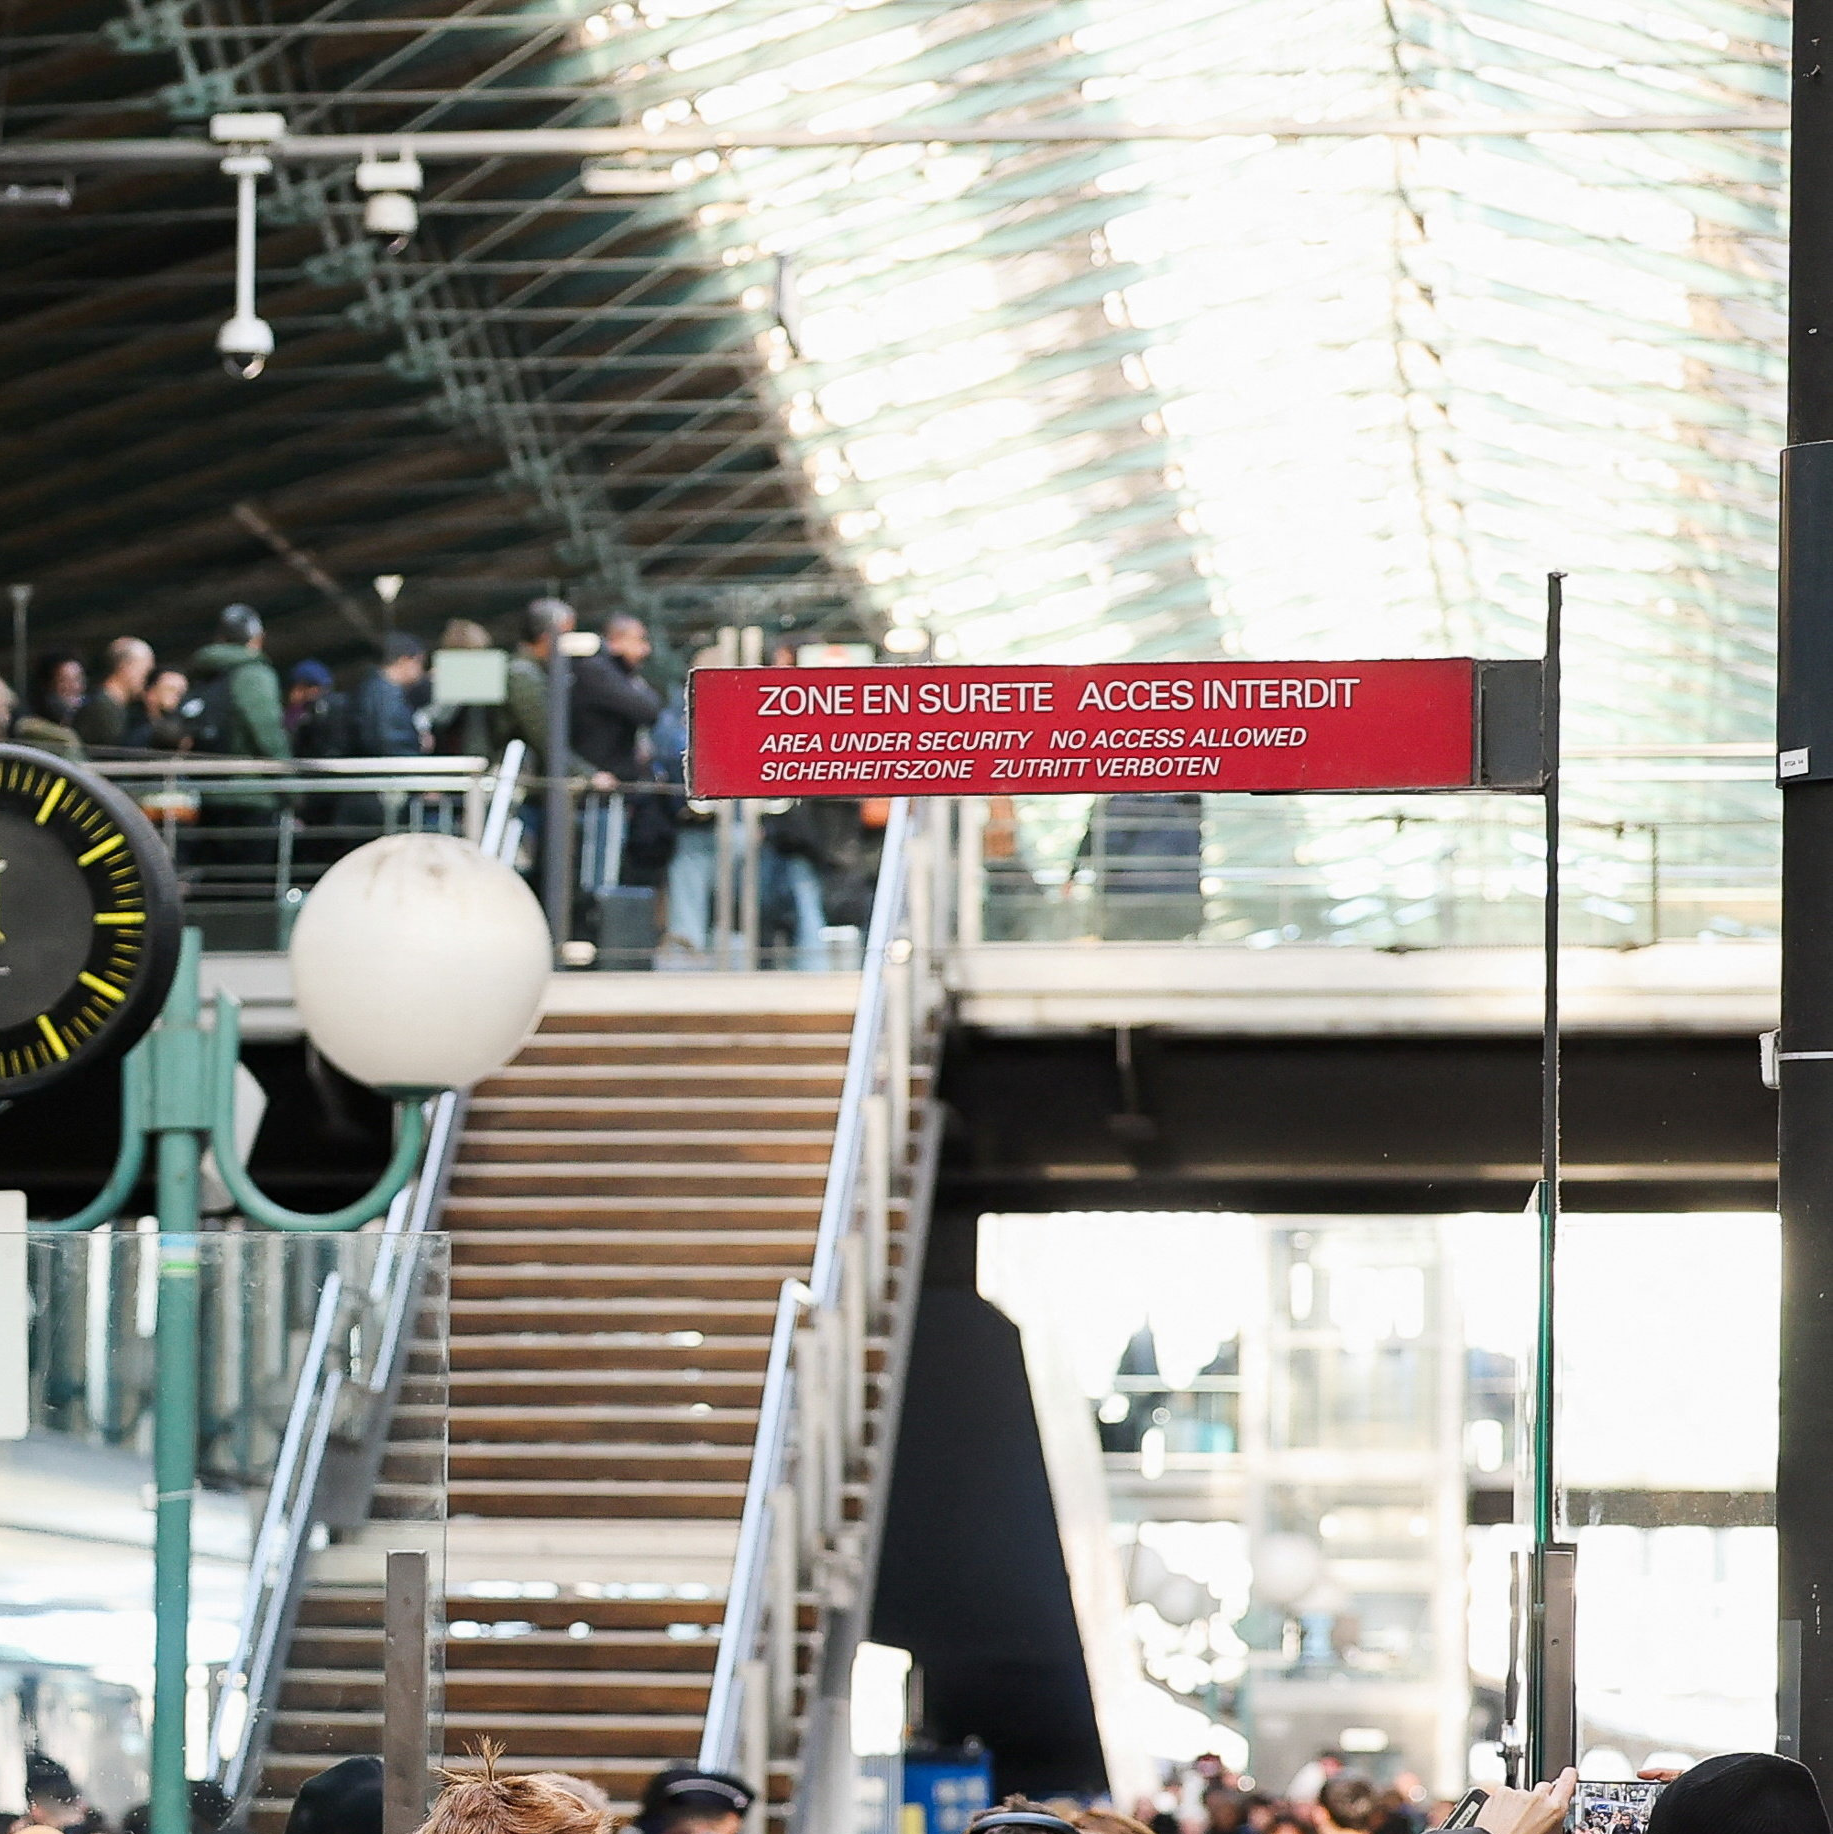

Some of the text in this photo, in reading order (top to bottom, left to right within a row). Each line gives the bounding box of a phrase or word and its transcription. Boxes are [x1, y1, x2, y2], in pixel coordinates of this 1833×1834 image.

[757, 677, 1361, 717] ZONE EN SURETE ACCES INTERDIT
[758, 726, 1308, 754] AREA UNDER SECURITY NO ACCESS ALLOWED
[759, 755, 1221, 782] SICHERHEITSZONE ZUTRITT VERBOTEN
